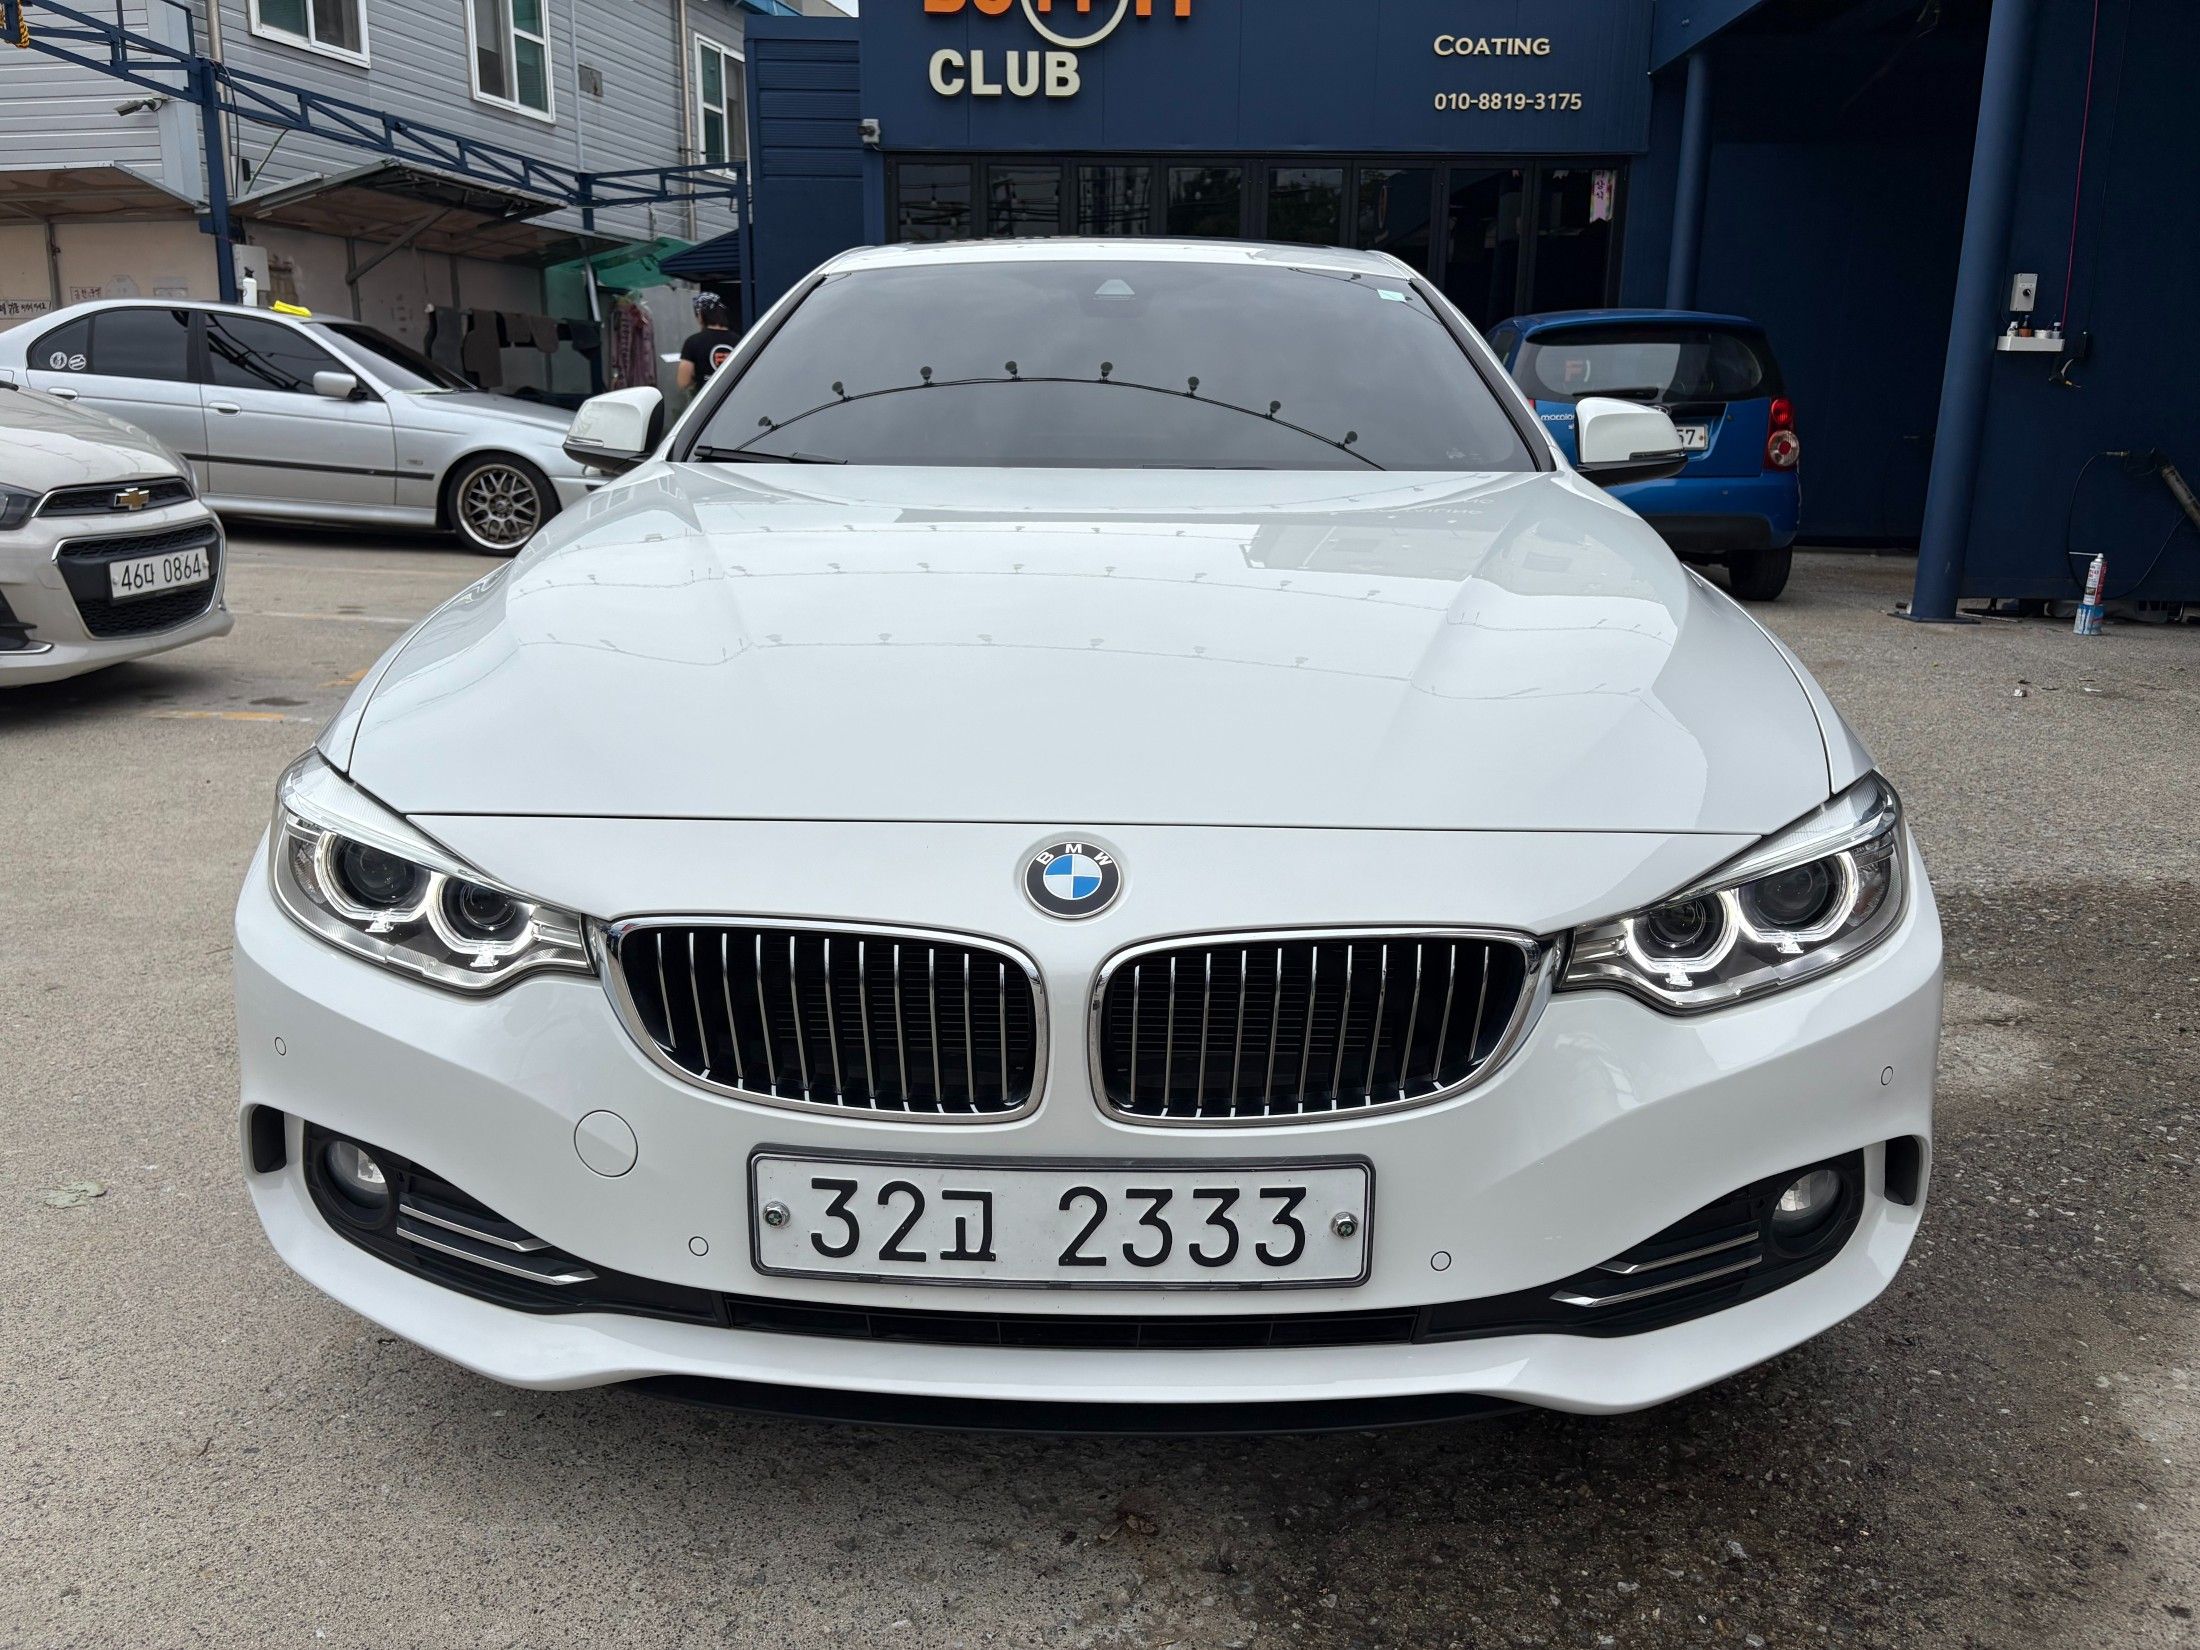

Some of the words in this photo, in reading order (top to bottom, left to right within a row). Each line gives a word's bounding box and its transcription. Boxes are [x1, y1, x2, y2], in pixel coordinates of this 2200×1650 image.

[928, 48, 1081, 96] CLUB
[1434, 92, 1582, 110] 010-8819-3175
[121, 563, 155, 591] 46다
[163, 552, 202, 583] 0864
[1035, 843, 1113, 866] BMW
[810, 1177, 997, 1263] 32고
[1057, 1185, 1308, 1268] 2333
